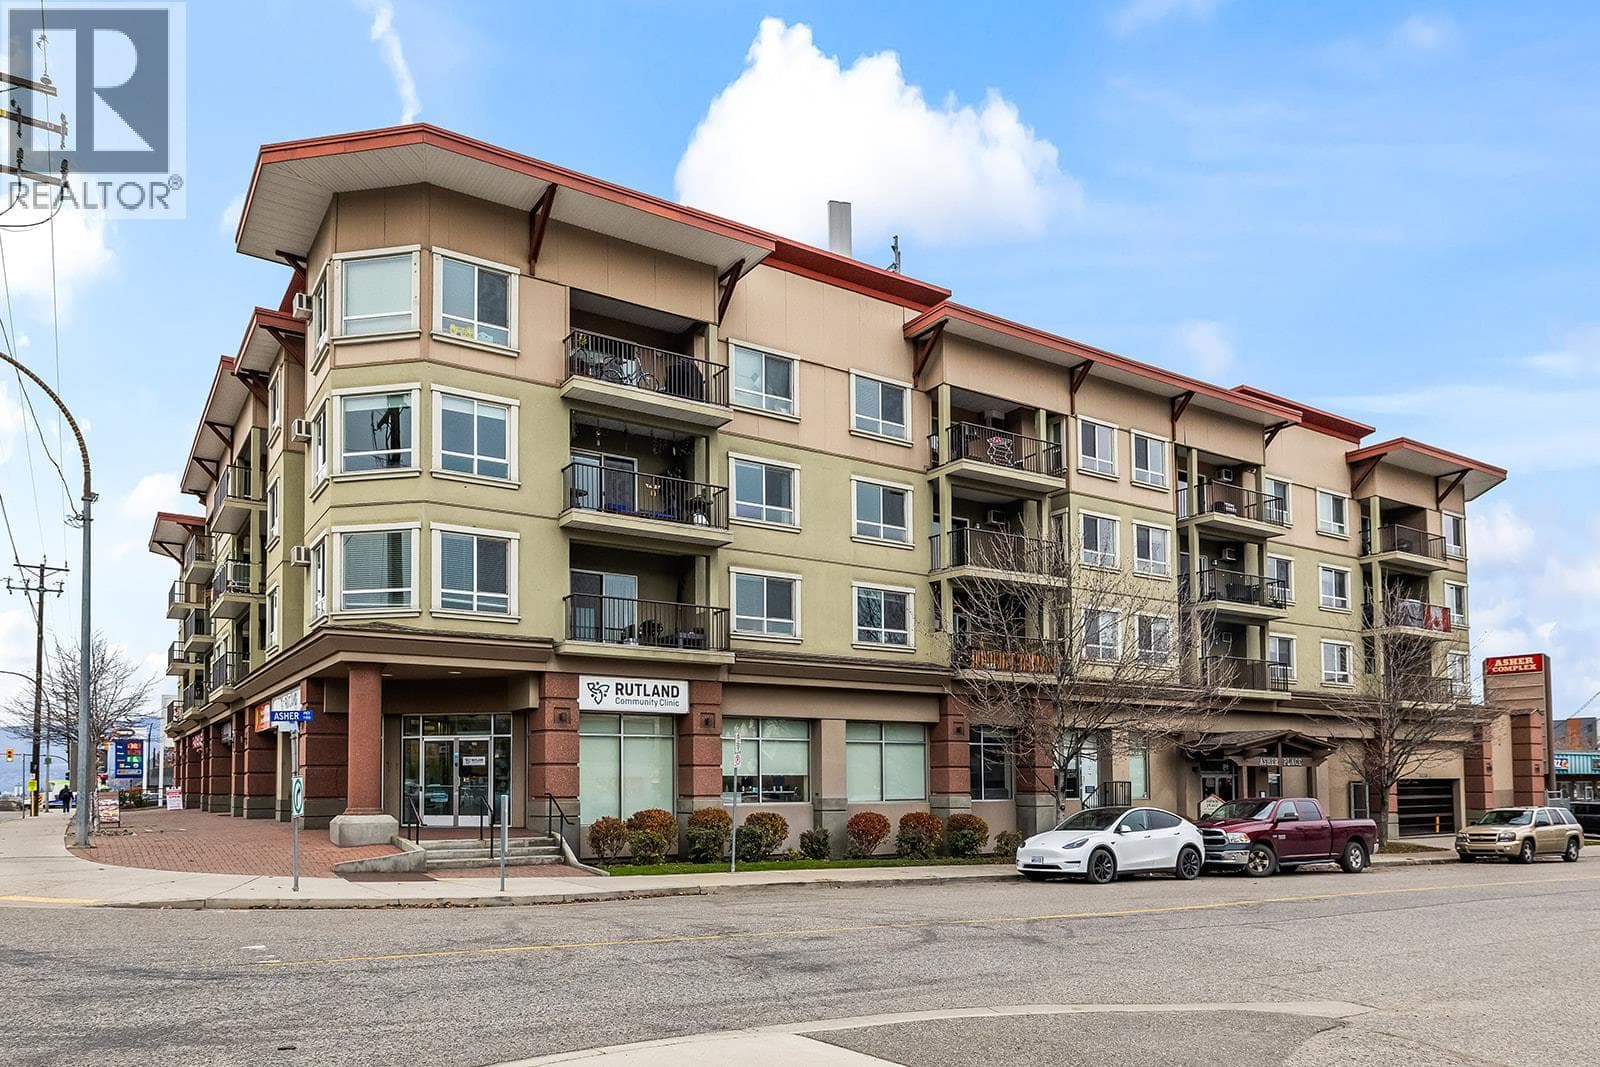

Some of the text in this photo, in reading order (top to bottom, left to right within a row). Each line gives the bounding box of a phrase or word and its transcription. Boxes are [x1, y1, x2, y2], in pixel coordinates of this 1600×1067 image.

[1495, 657, 1534, 667] ASHER
[1492, 664, 1537, 673] COMPLEX
[615, 682, 680, 698] RUTLAND
[615, 697, 680, 707] Community Clinic
[273, 711, 300, 721] ASHER
